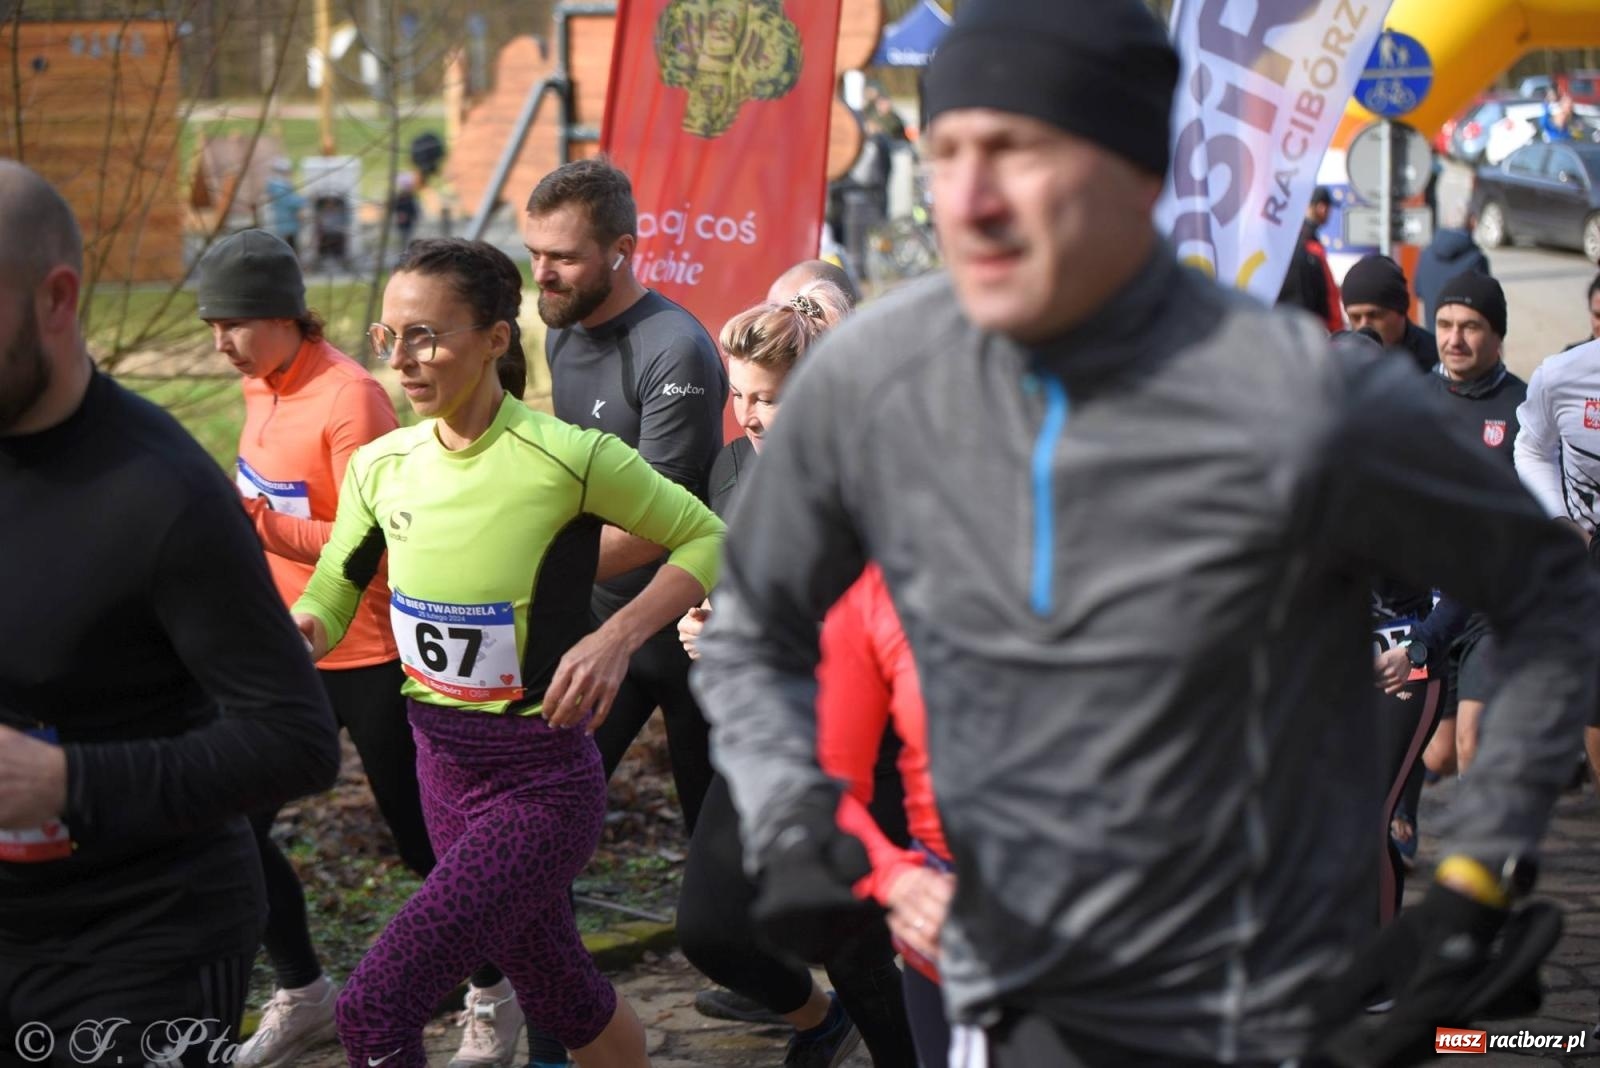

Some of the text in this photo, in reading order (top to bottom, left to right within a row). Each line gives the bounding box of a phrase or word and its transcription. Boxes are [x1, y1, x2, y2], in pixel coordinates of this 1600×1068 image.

[1261, 0, 1368, 226] RACIBÓRZ
[694, 210, 757, 245] coś
[405, 598, 427, 611] BIEG
[426, 602, 497, 617] TWARDZIELA
[415, 622, 483, 677] 67
